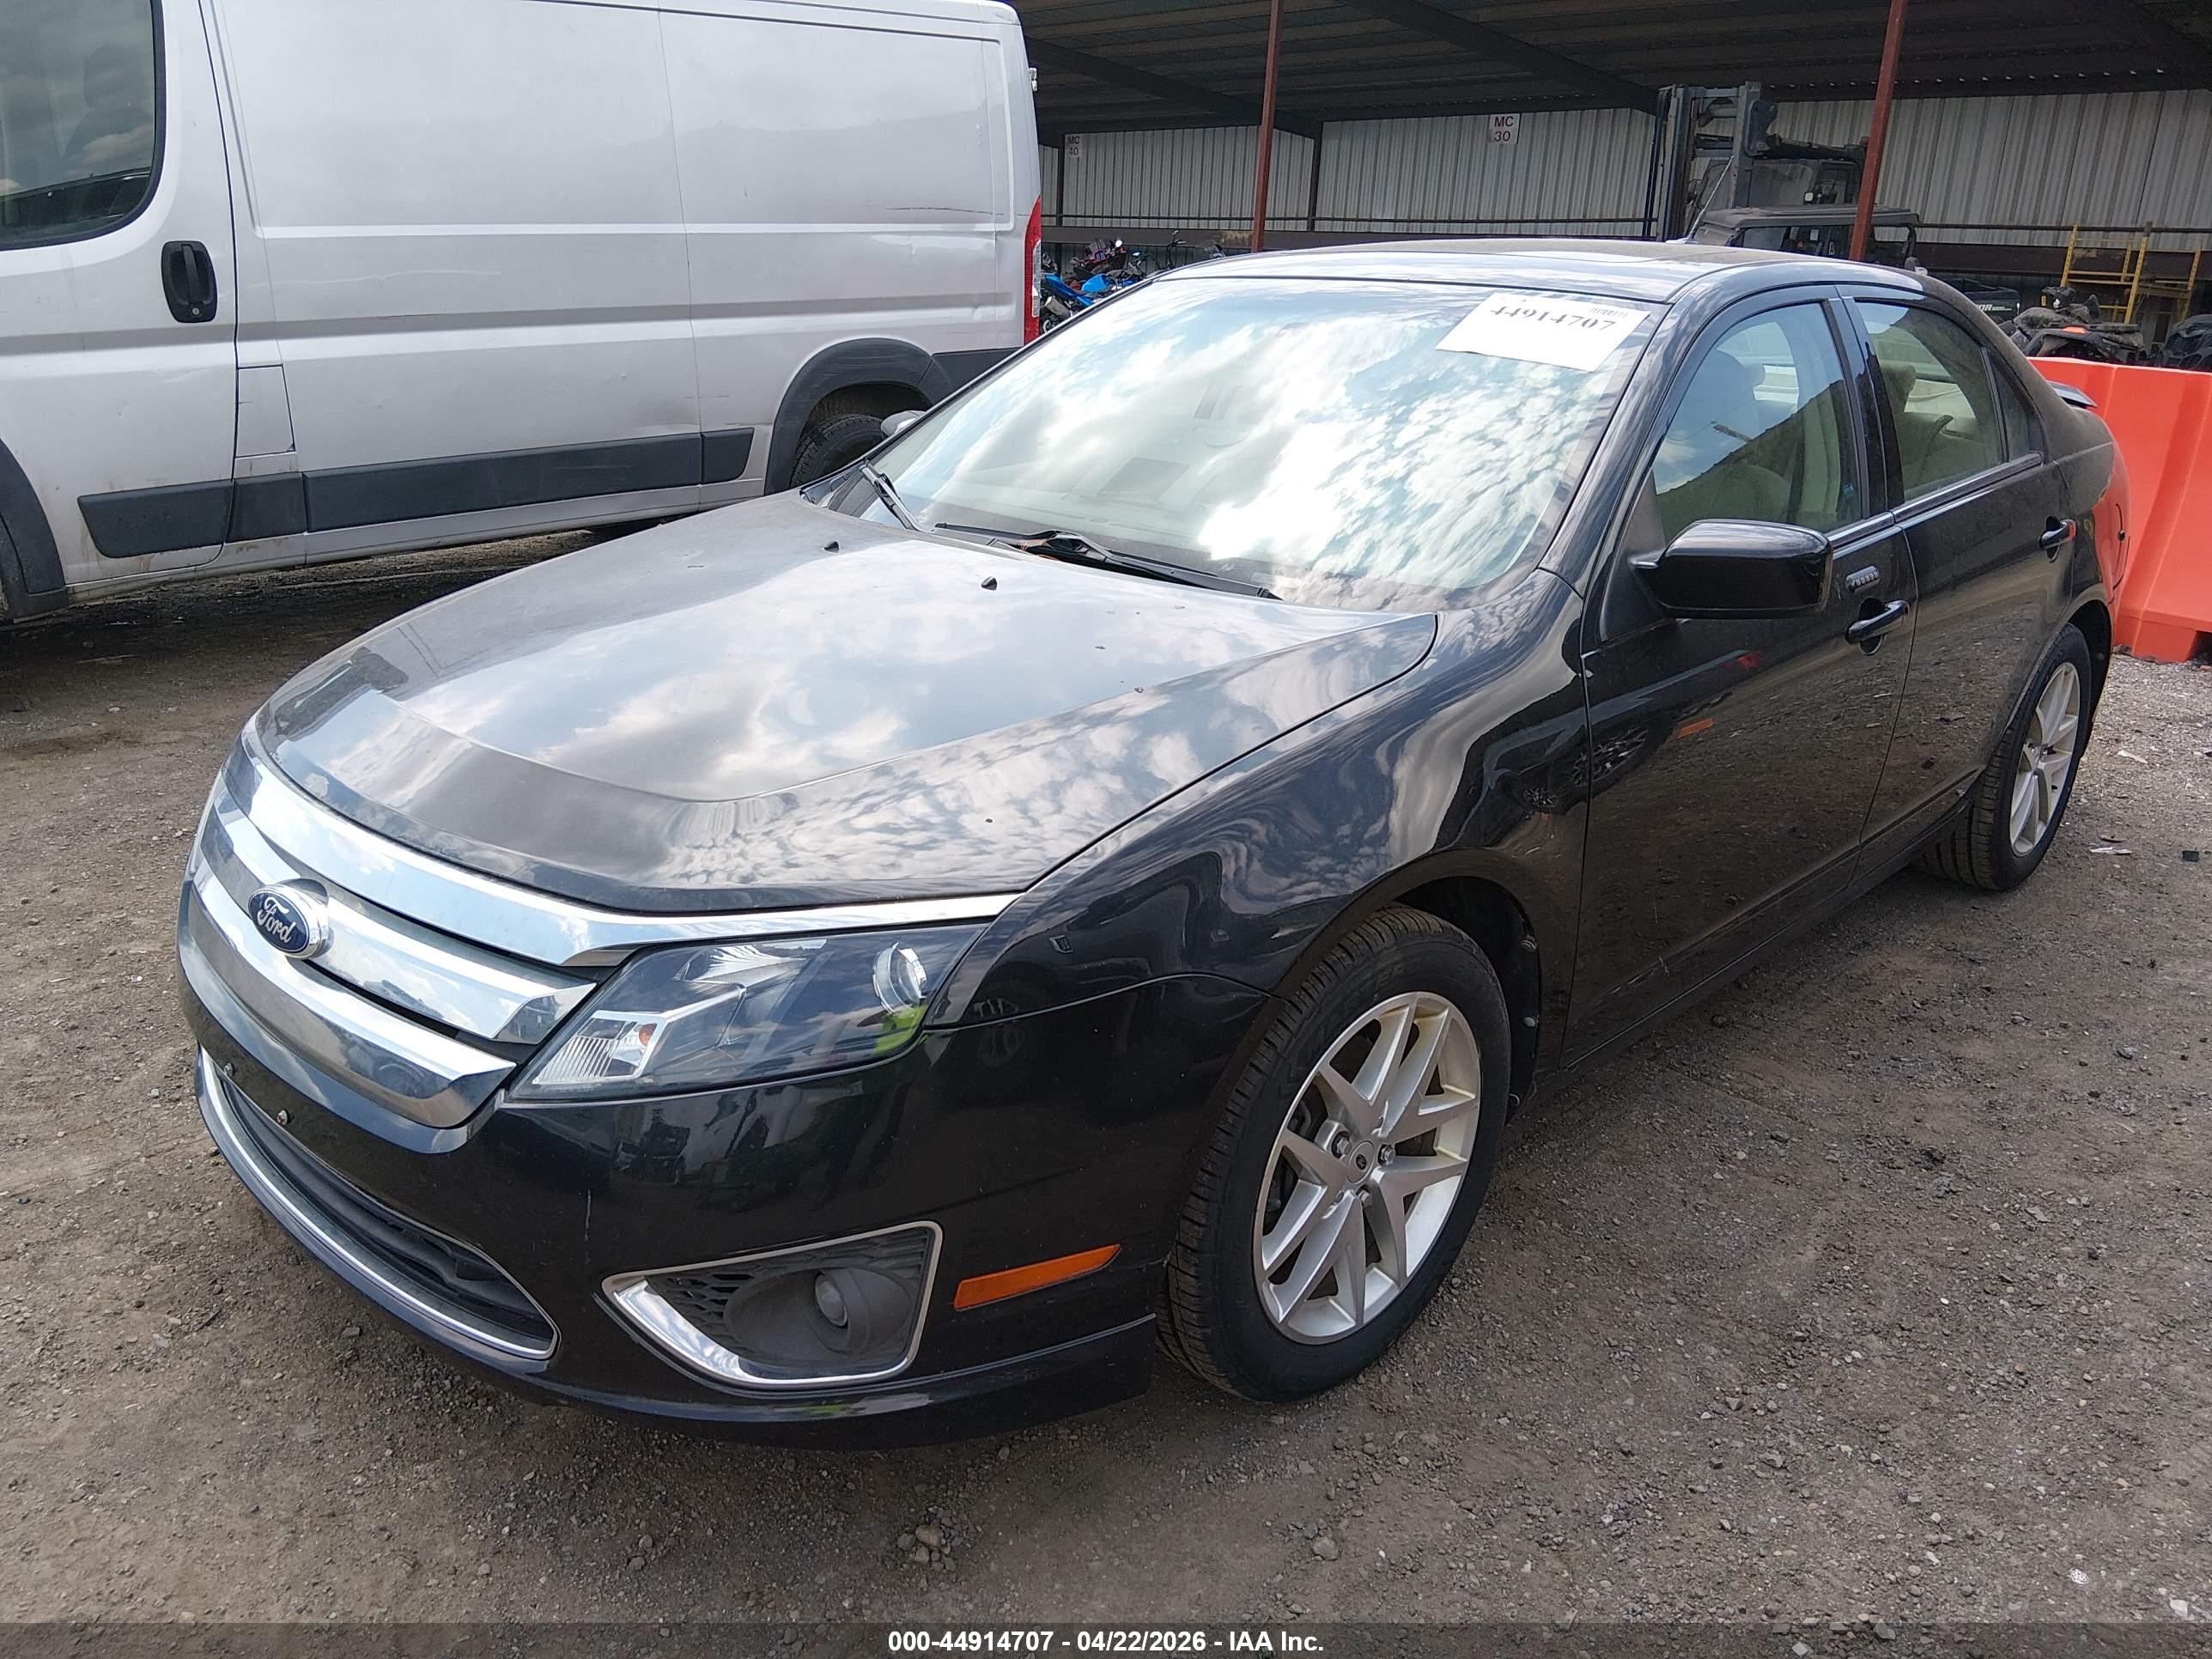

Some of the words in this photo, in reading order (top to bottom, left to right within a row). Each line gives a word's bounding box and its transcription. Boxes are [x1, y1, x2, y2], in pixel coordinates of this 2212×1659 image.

[1494, 116, 1514, 127] MC
[1067, 136, 1080, 145] MC
[1494, 131, 1511, 142] 30
[256, 896, 297, 943] Ford
